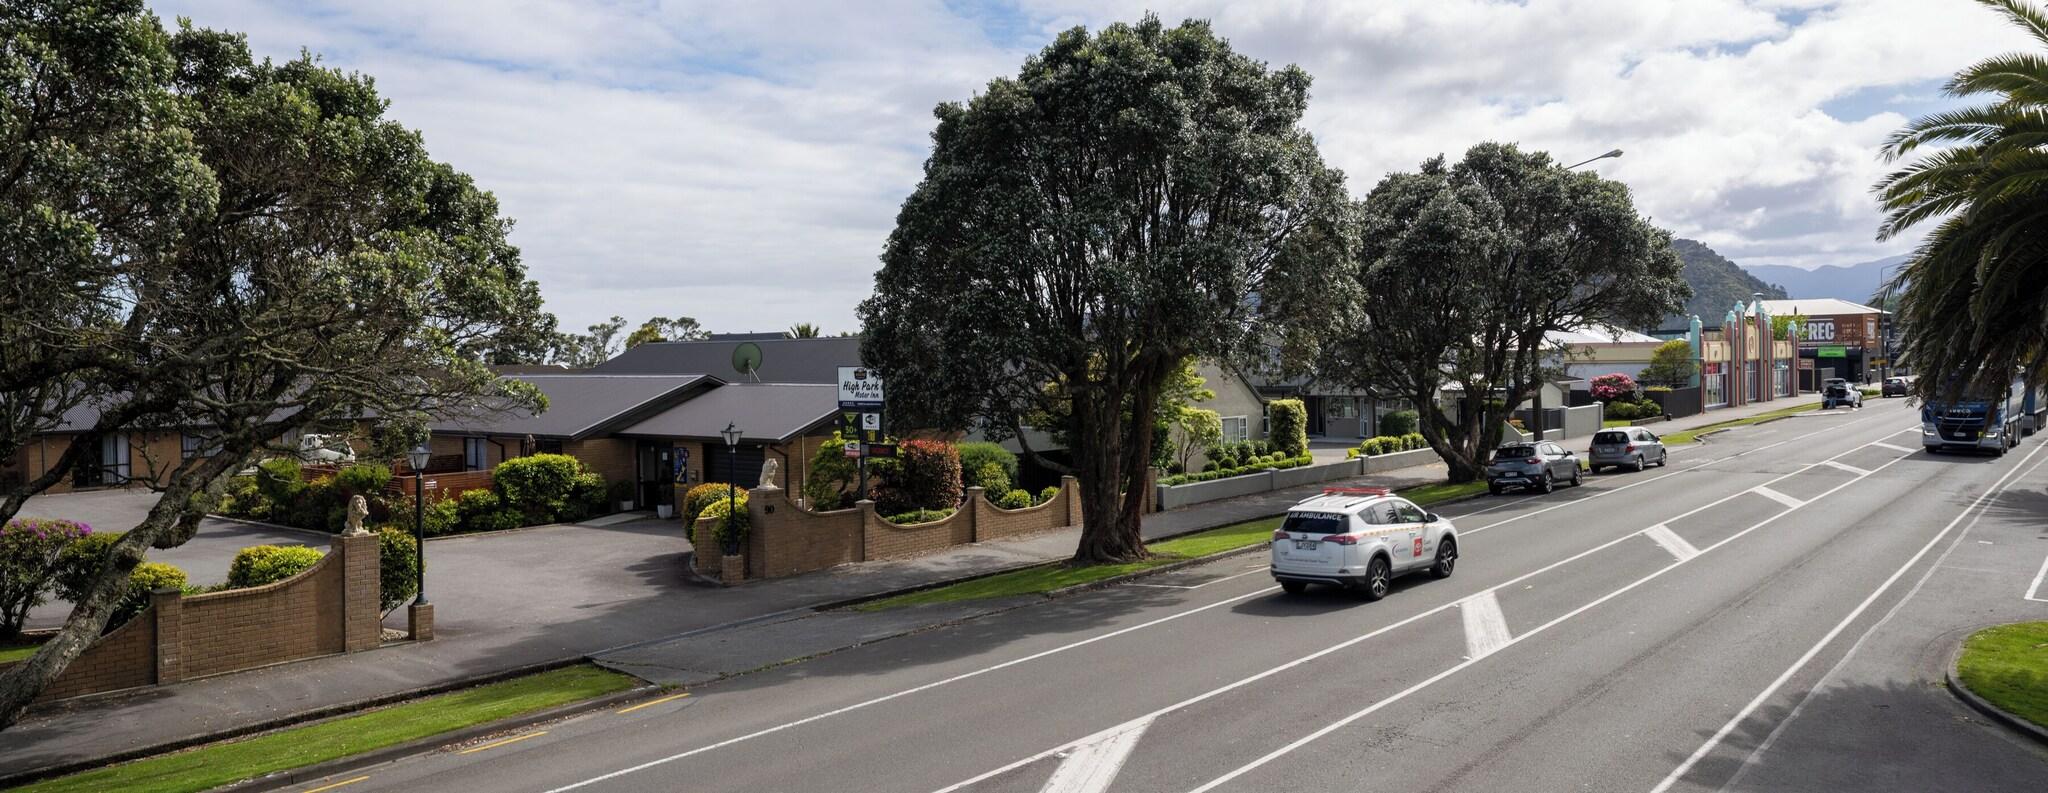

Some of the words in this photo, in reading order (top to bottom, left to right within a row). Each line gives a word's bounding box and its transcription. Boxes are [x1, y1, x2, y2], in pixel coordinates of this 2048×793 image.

[843, 381, 860, 394] High
[862, 381, 879, 391] Park
[1299, 512, 1342, 520] AMBULANCE
